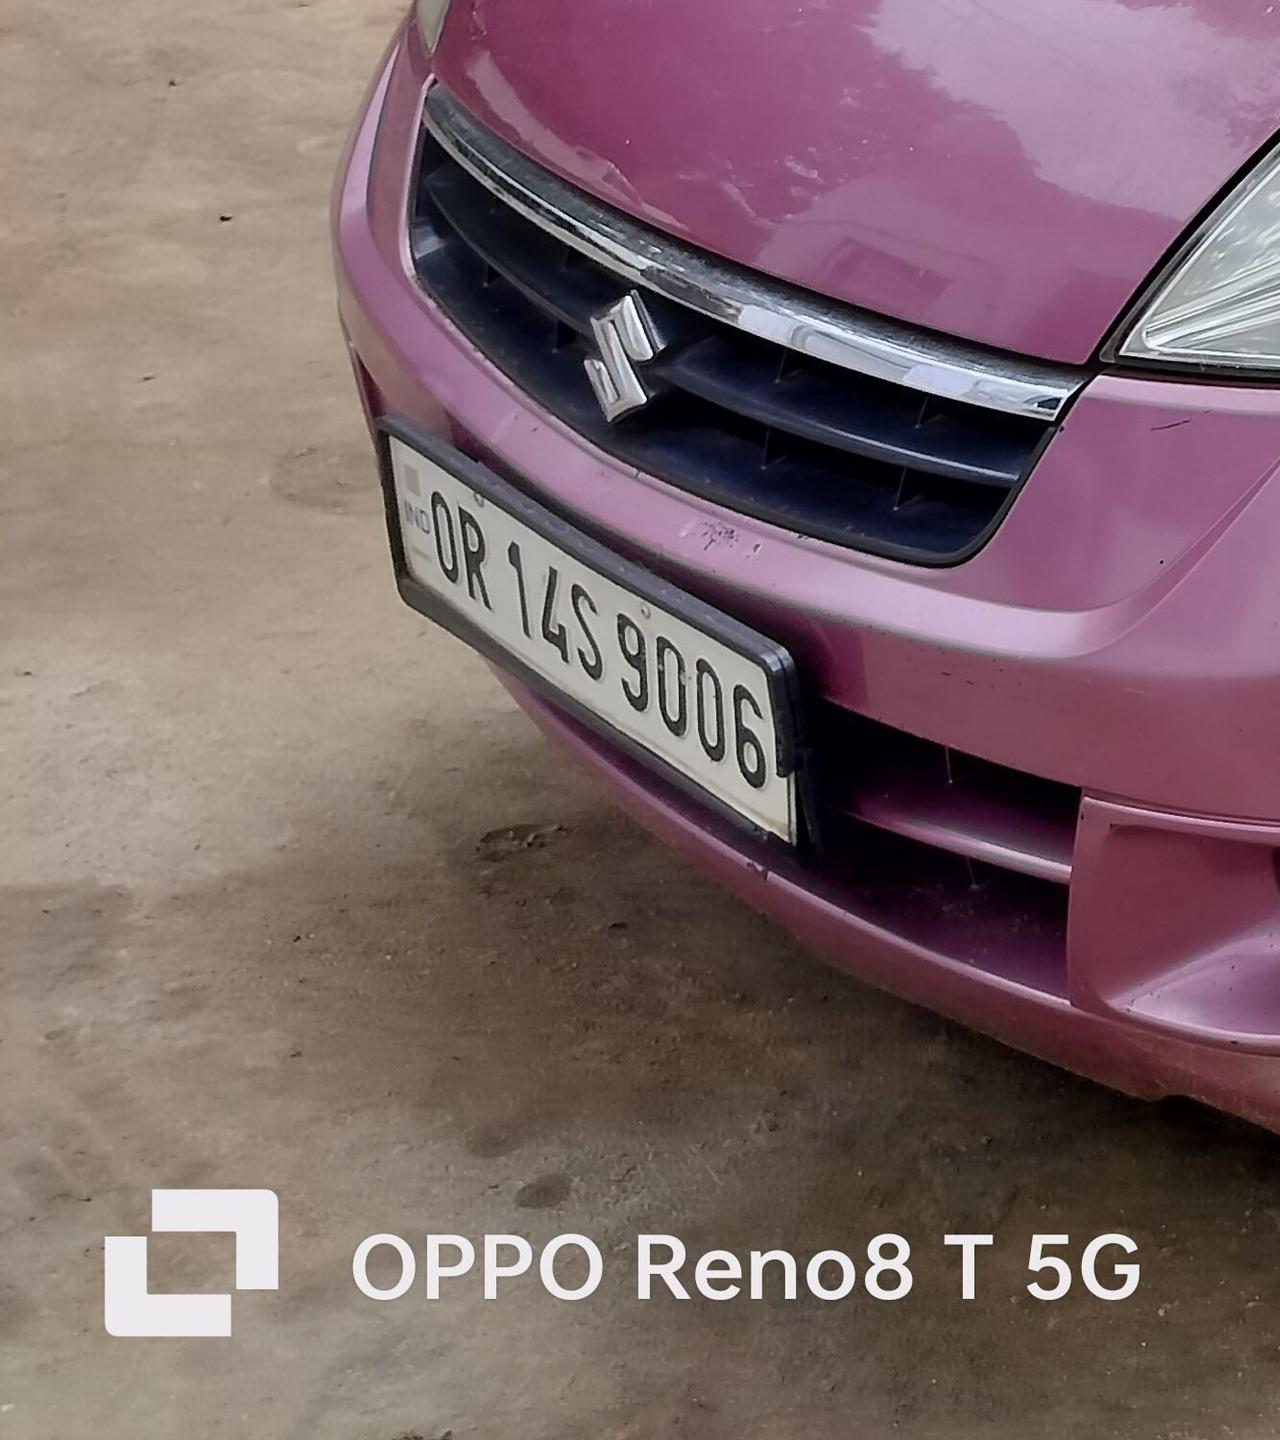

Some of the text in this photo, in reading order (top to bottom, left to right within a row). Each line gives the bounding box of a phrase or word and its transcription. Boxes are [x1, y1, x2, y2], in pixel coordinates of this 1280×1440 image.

[403, 499, 431, 535] IND
[430, 491, 493, 611] OR
[616, 612, 767, 790] 9006
